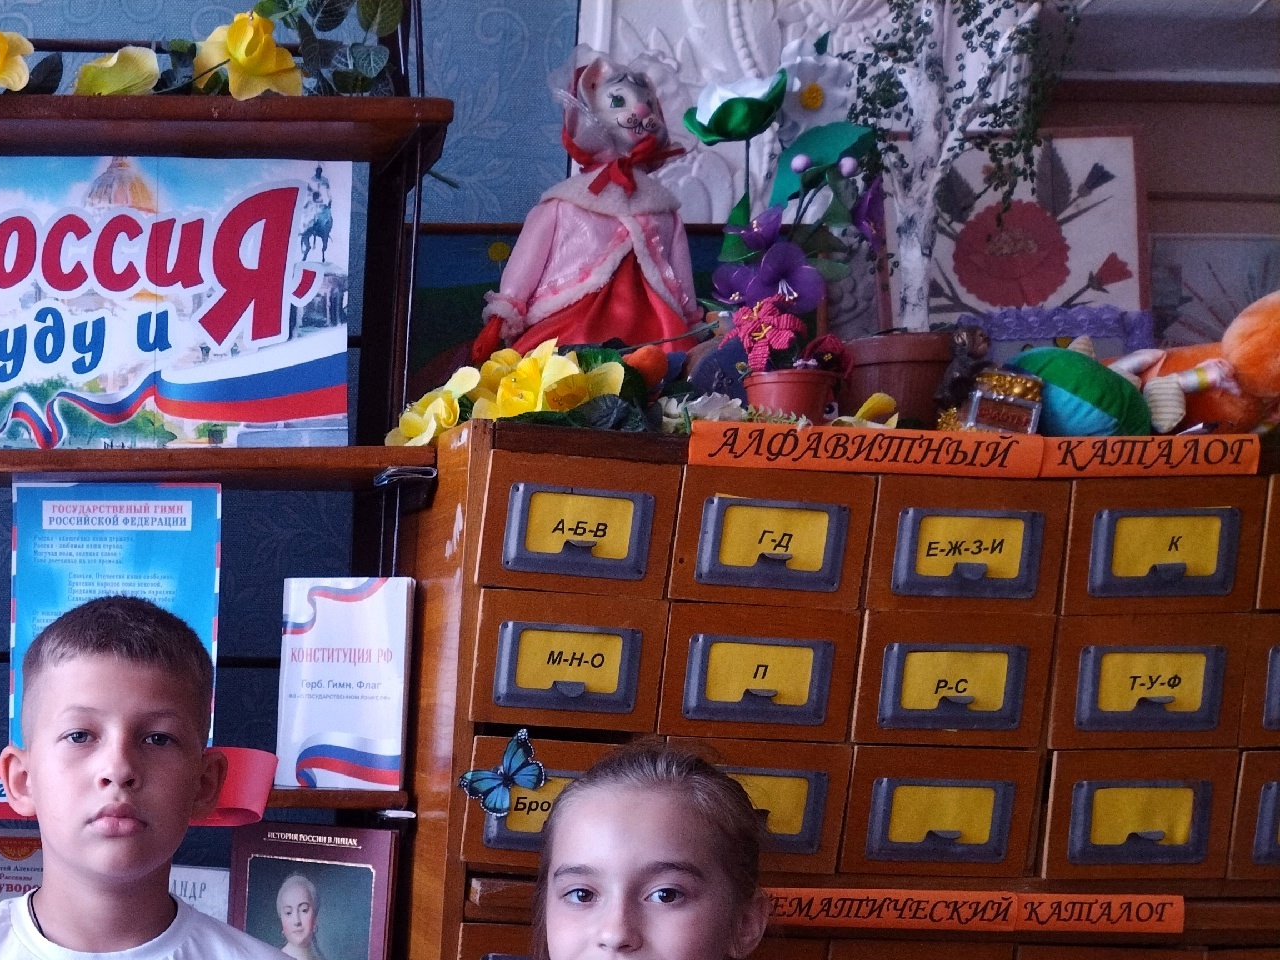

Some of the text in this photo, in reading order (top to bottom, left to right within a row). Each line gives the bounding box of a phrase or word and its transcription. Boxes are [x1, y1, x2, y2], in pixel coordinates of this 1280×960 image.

[136, 310, 172, 353] и
[708, 427, 1255, 469] АЛФАВИТНЫЙ КАТАЛОГ
[153, 505, 184, 515] ГИМН
[48, 514, 187, 528] РОССИЙСКОЙ ФЕДЕРАЦИИ
[551, 518, 608, 540] А-Б-В
[757, 529, 794, 552] Г-Д
[925, 538, 1005, 558] Е-Ж-З-И
[1168, 535, 1184, 552] К
[290, 648, 393, 667] КОНСТИТУЦИЯ РФ
[546, 650, 606, 670] М-Н-О
[752, 664, 770, 681] П
[357, 680, 382, 690] Флаг
[933, 678, 969, 696] Р-С
[1128, 675, 1183, 692] Т-У-Ф
[514, 795, 553, 817] Бро
[267, 832, 299, 842] ИСТОРИЯ
[170, 879, 207, 899] АНДР
[767, 894, 1174, 926] ЕМАТИЧЕСКИЙ КАТАЛОГ
